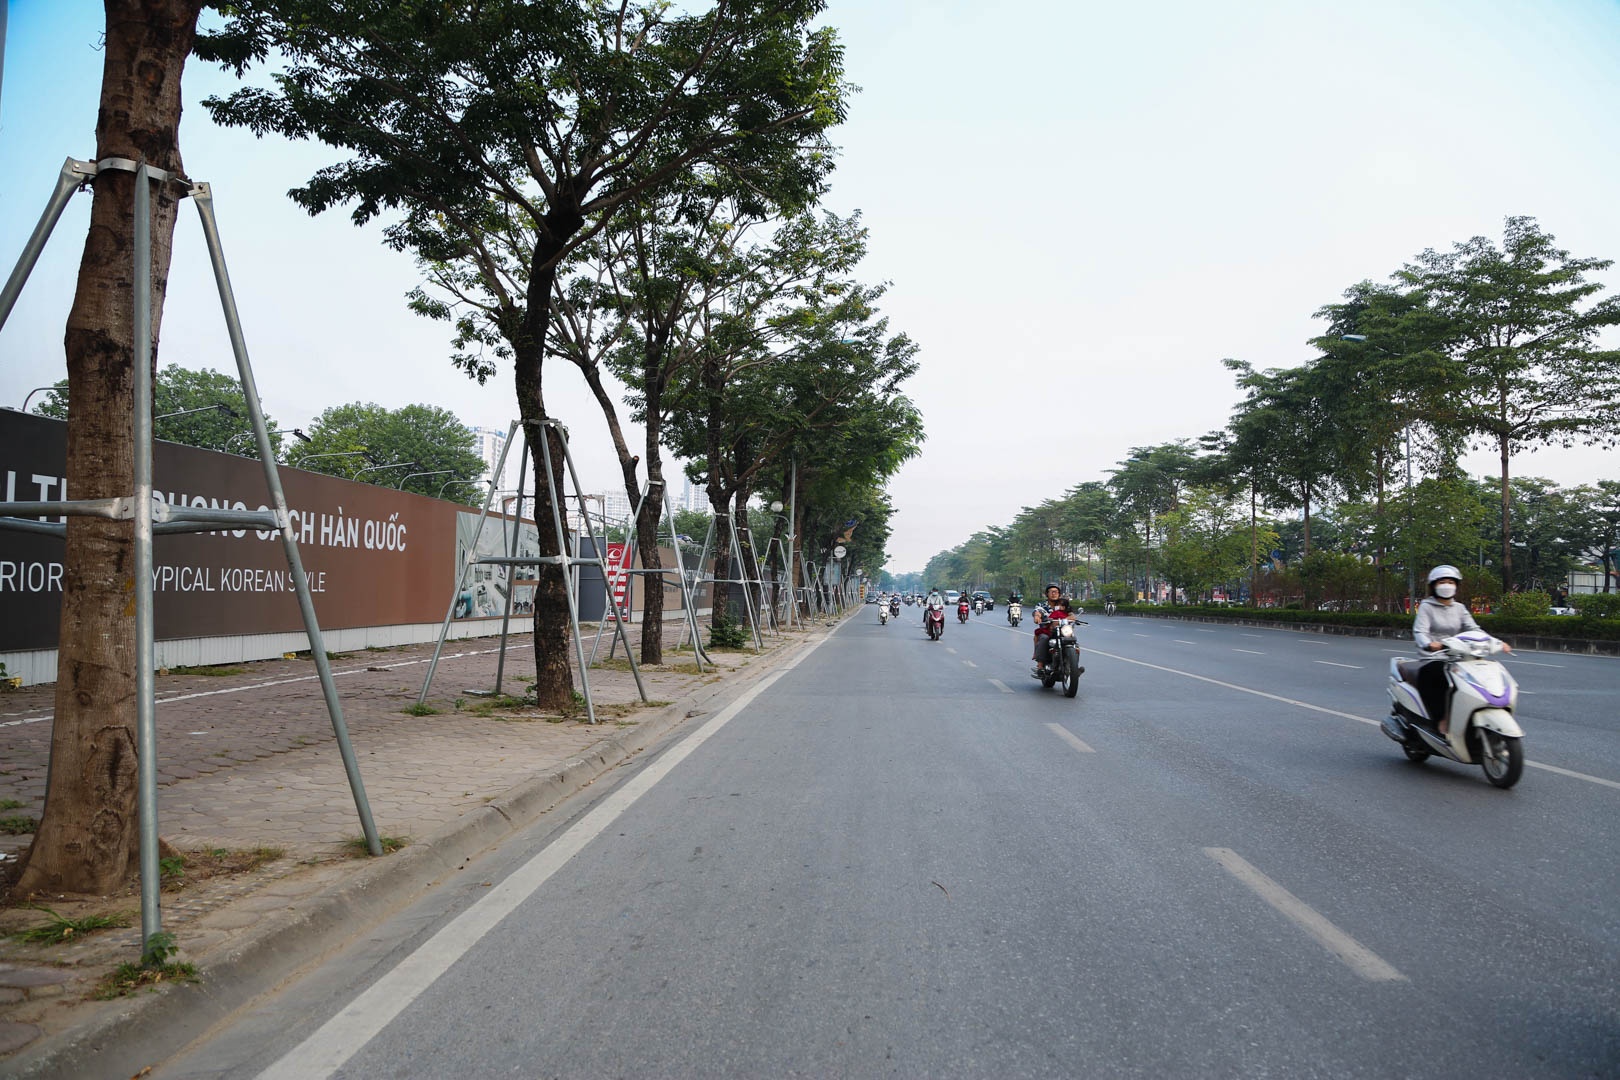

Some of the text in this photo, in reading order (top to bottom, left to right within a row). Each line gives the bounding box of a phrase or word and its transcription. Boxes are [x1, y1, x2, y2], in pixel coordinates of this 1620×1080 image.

[320, 506, 359, 549] HÀN
[364, 512, 406, 552] QUỐC
[0, 561, 63, 592] RIOR
[221, 567, 284, 592] KOREAN
[288, 571, 326, 592] SYLE
